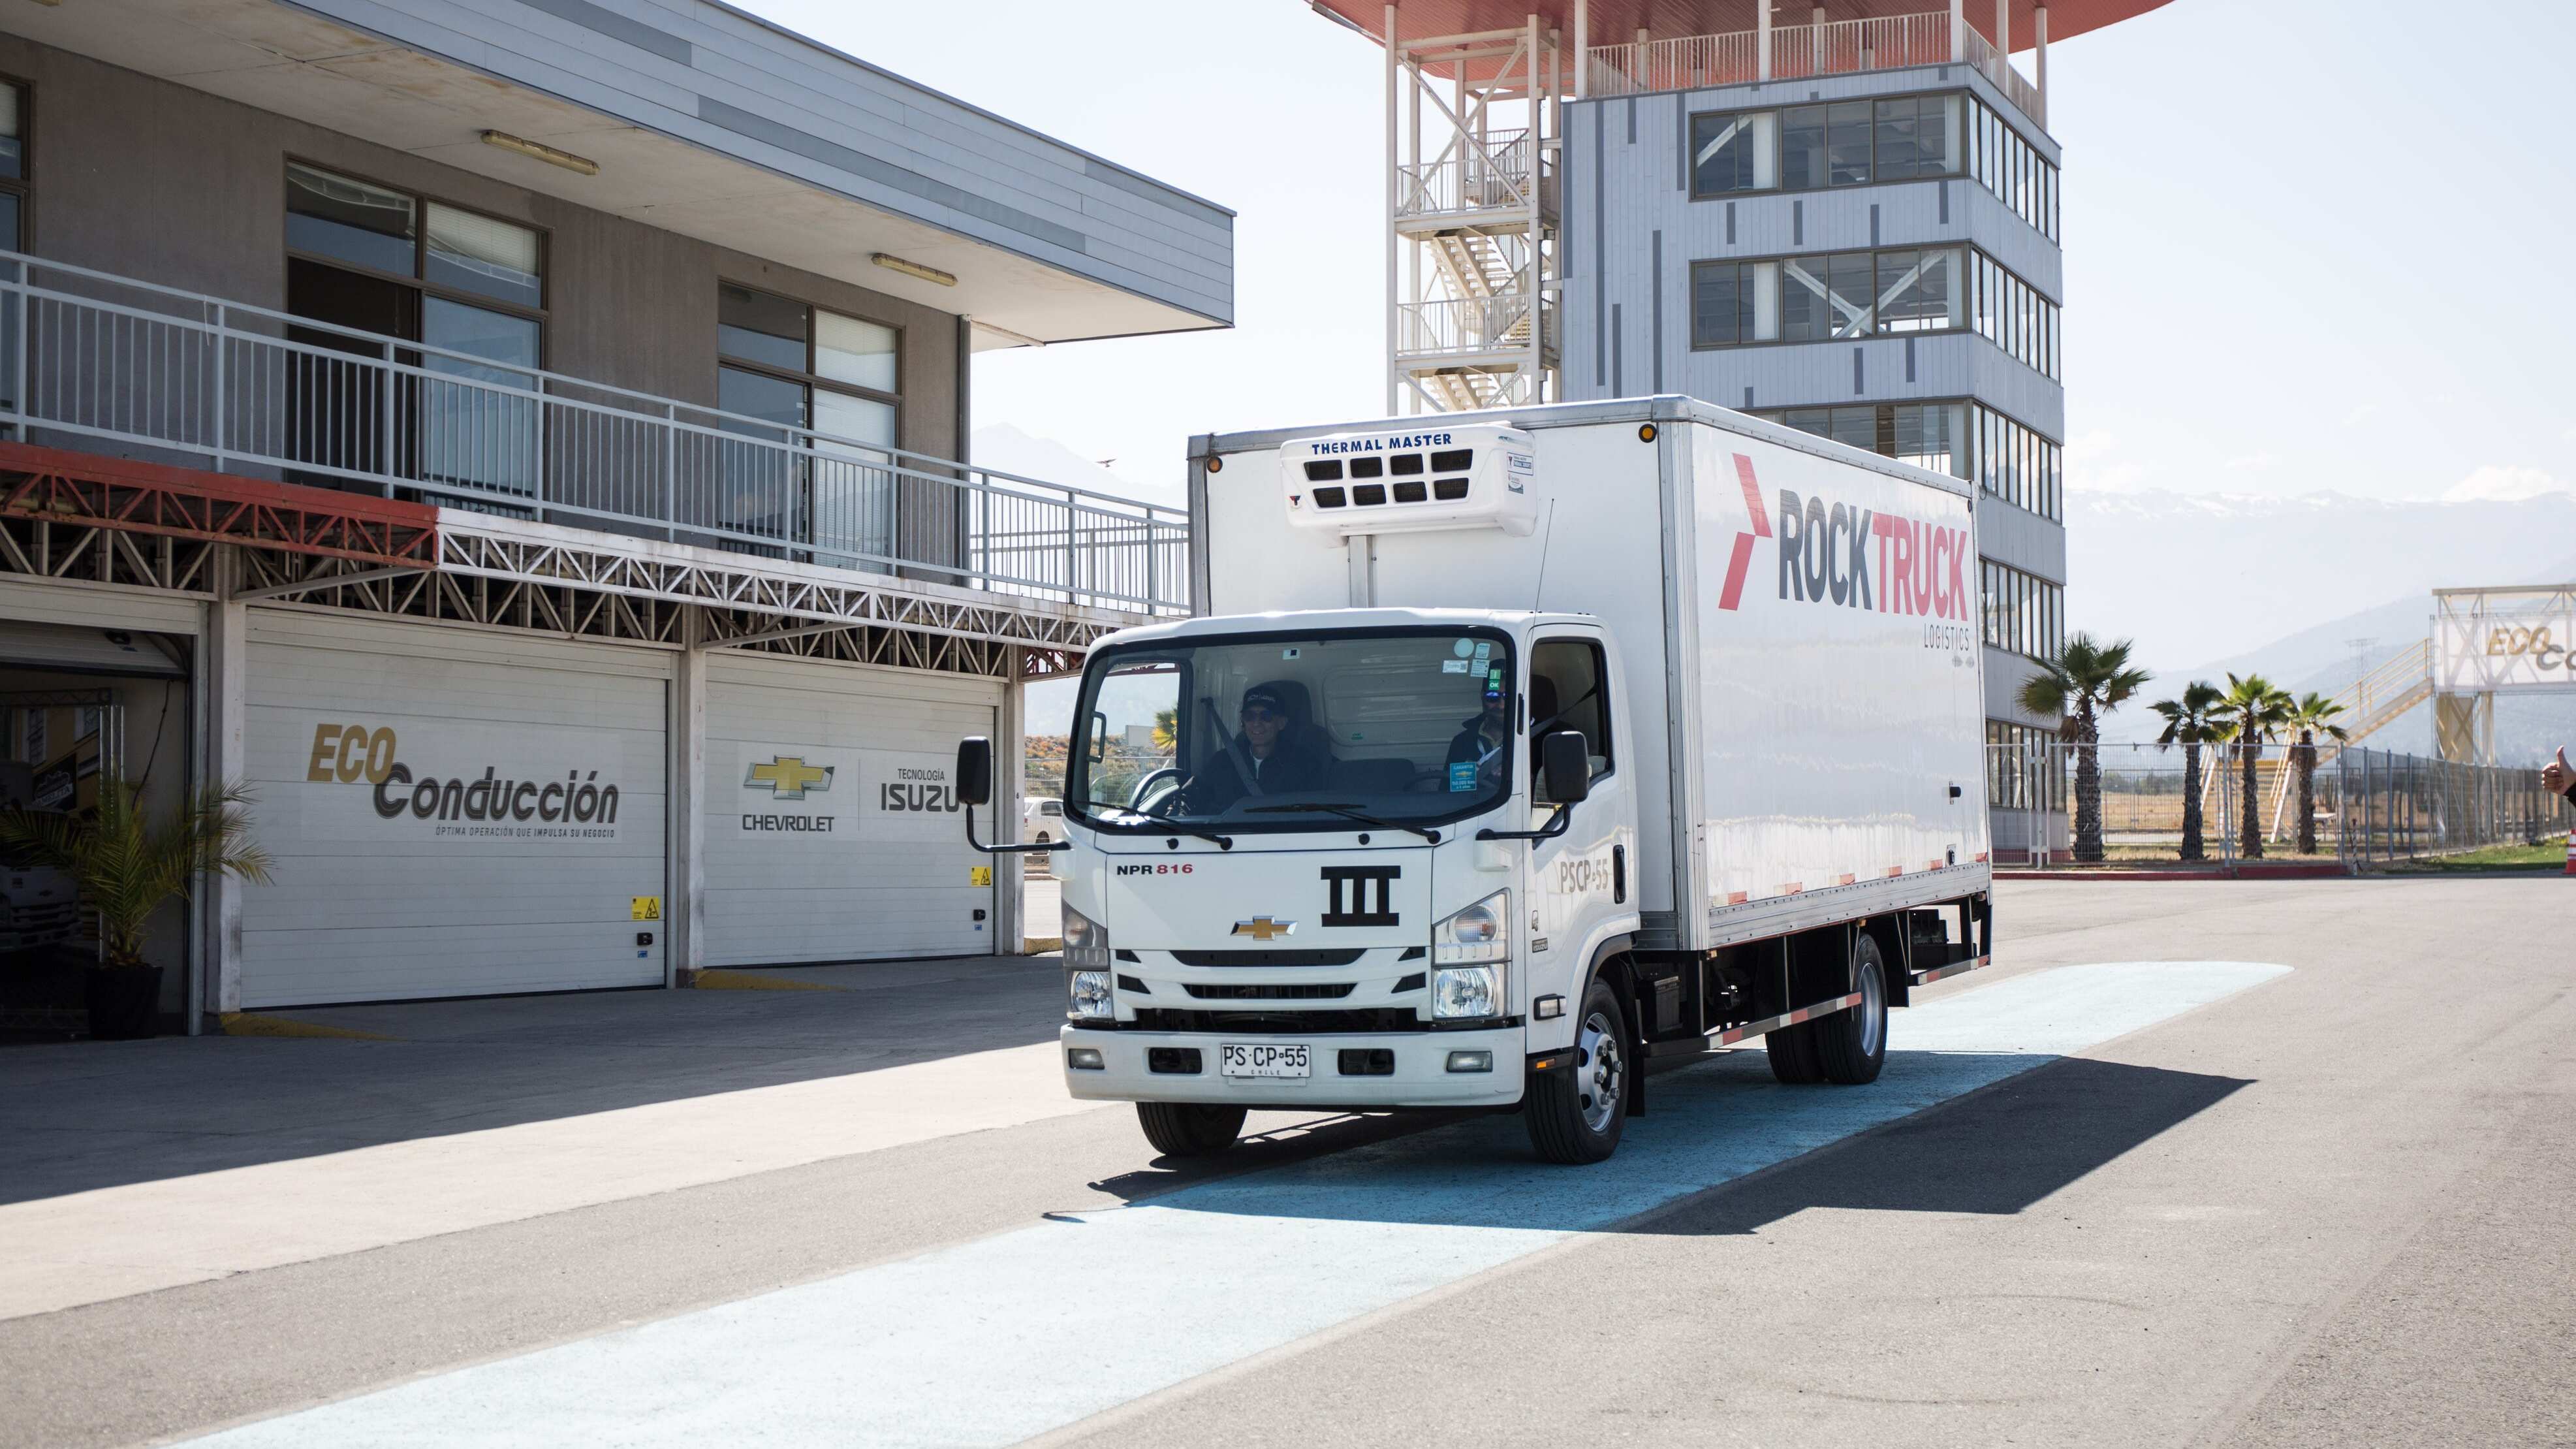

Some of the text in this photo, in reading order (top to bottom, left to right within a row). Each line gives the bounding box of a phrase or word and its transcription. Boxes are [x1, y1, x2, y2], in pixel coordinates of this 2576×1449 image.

[1312, 433, 1452, 455] THERMAL MASTER
[1779, 488, 1968, 622] ROCKTRUCK
[1924, 623, 1969, 652] LOGISTICS
[2487, 627, 2552, 656] ECO
[307, 723, 396, 784] ECO
[898, 768, 945, 781] TECNOLOGÍA
[373, 761, 620, 824] Conducción
[881, 783, 960, 812] ISUZU
[435, 825, 465, 836] ÓPTIMA
[469, 826, 513, 836] OPERACIÓN
[516, 827, 531, 836] QUE
[533, 828, 567, 837] IMPULSA
[582, 829, 614, 838] NEGOCIO
[742, 814, 834, 832] CHEVROLET
[1117, 864, 1193, 875] NPR 816
